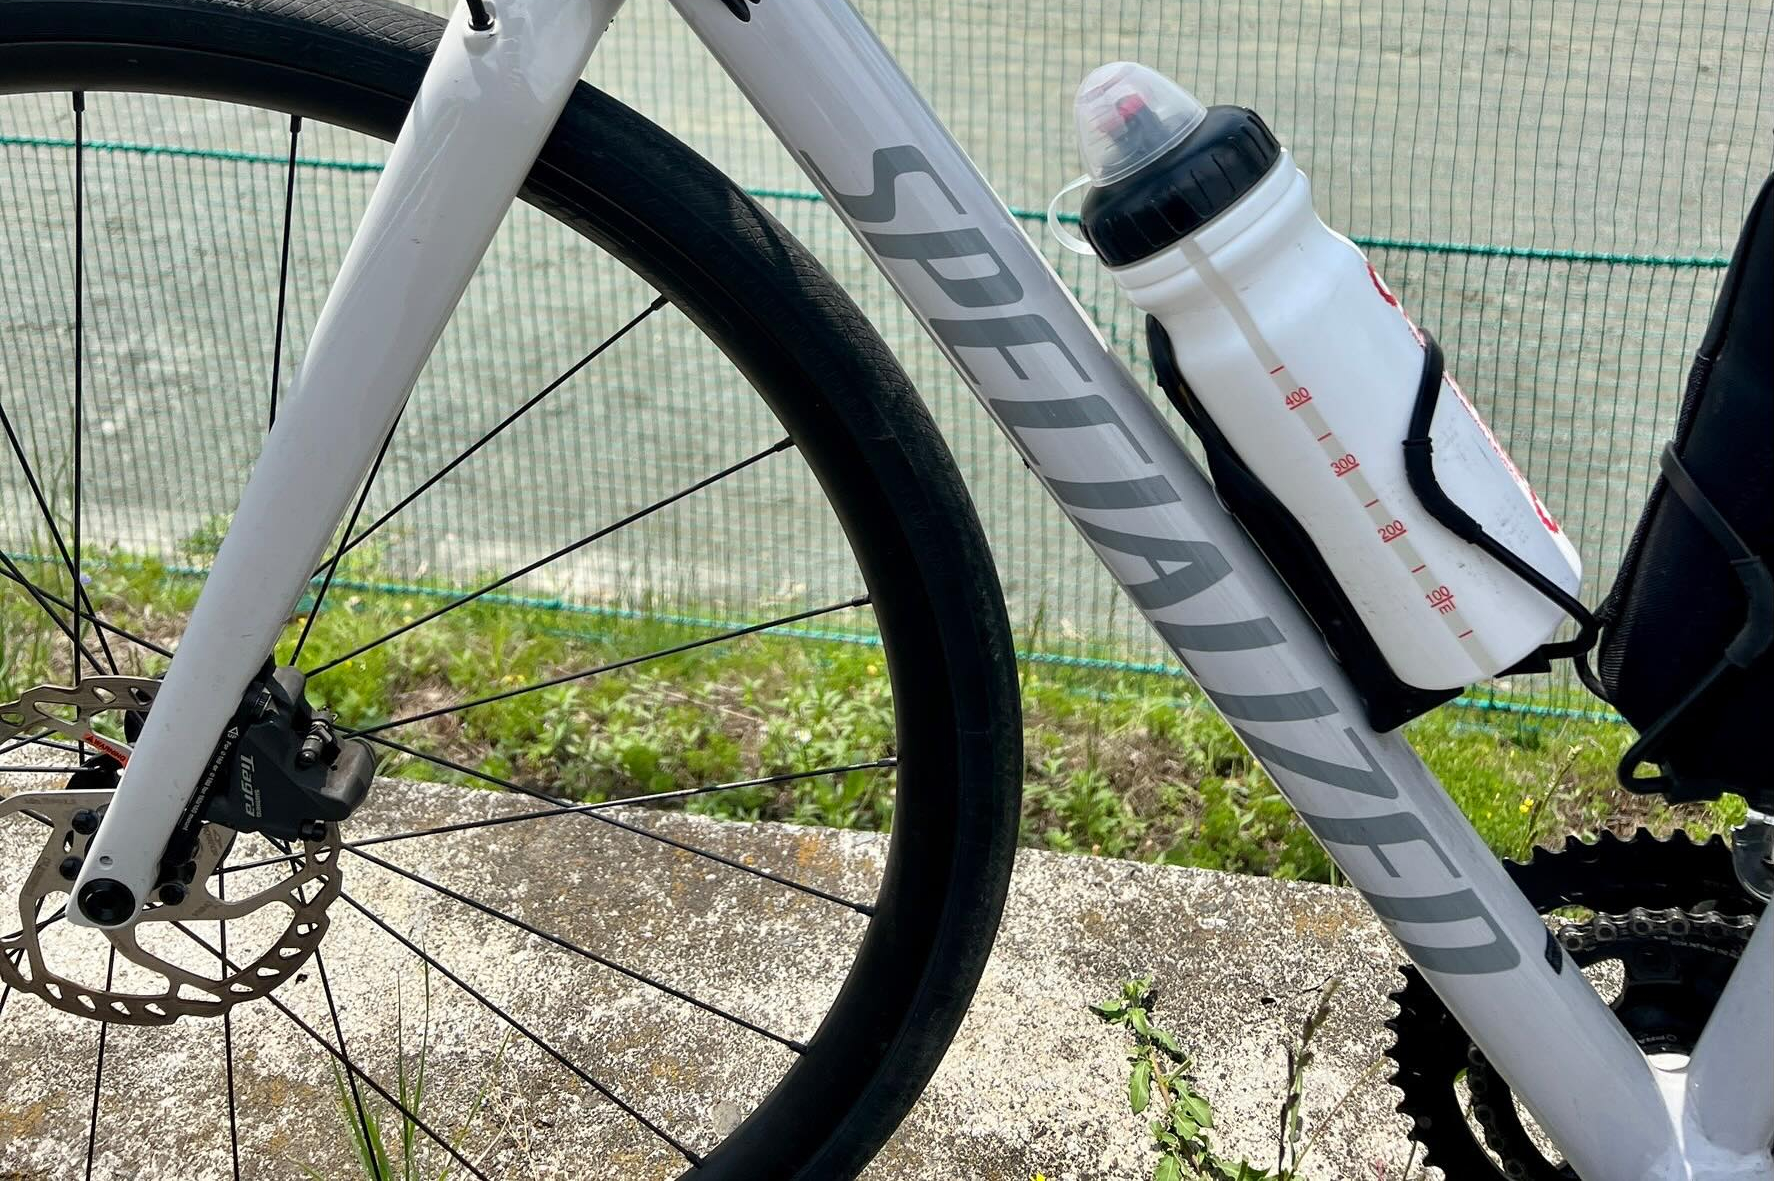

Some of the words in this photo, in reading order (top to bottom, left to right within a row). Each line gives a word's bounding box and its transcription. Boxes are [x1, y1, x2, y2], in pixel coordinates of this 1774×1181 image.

[1284, 386, 1310, 407] 400
[1330, 453, 1357, 475] 300
[1377, 519, 1404, 541] 200
[799, 144, 1521, 975] SPECIALIZED
[1425, 585, 1450, 607] 100
[1438, 598, 1457, 616] ml
[94, 736, 127, 763] WARNING
[240, 754, 256, 818] Tiagra
